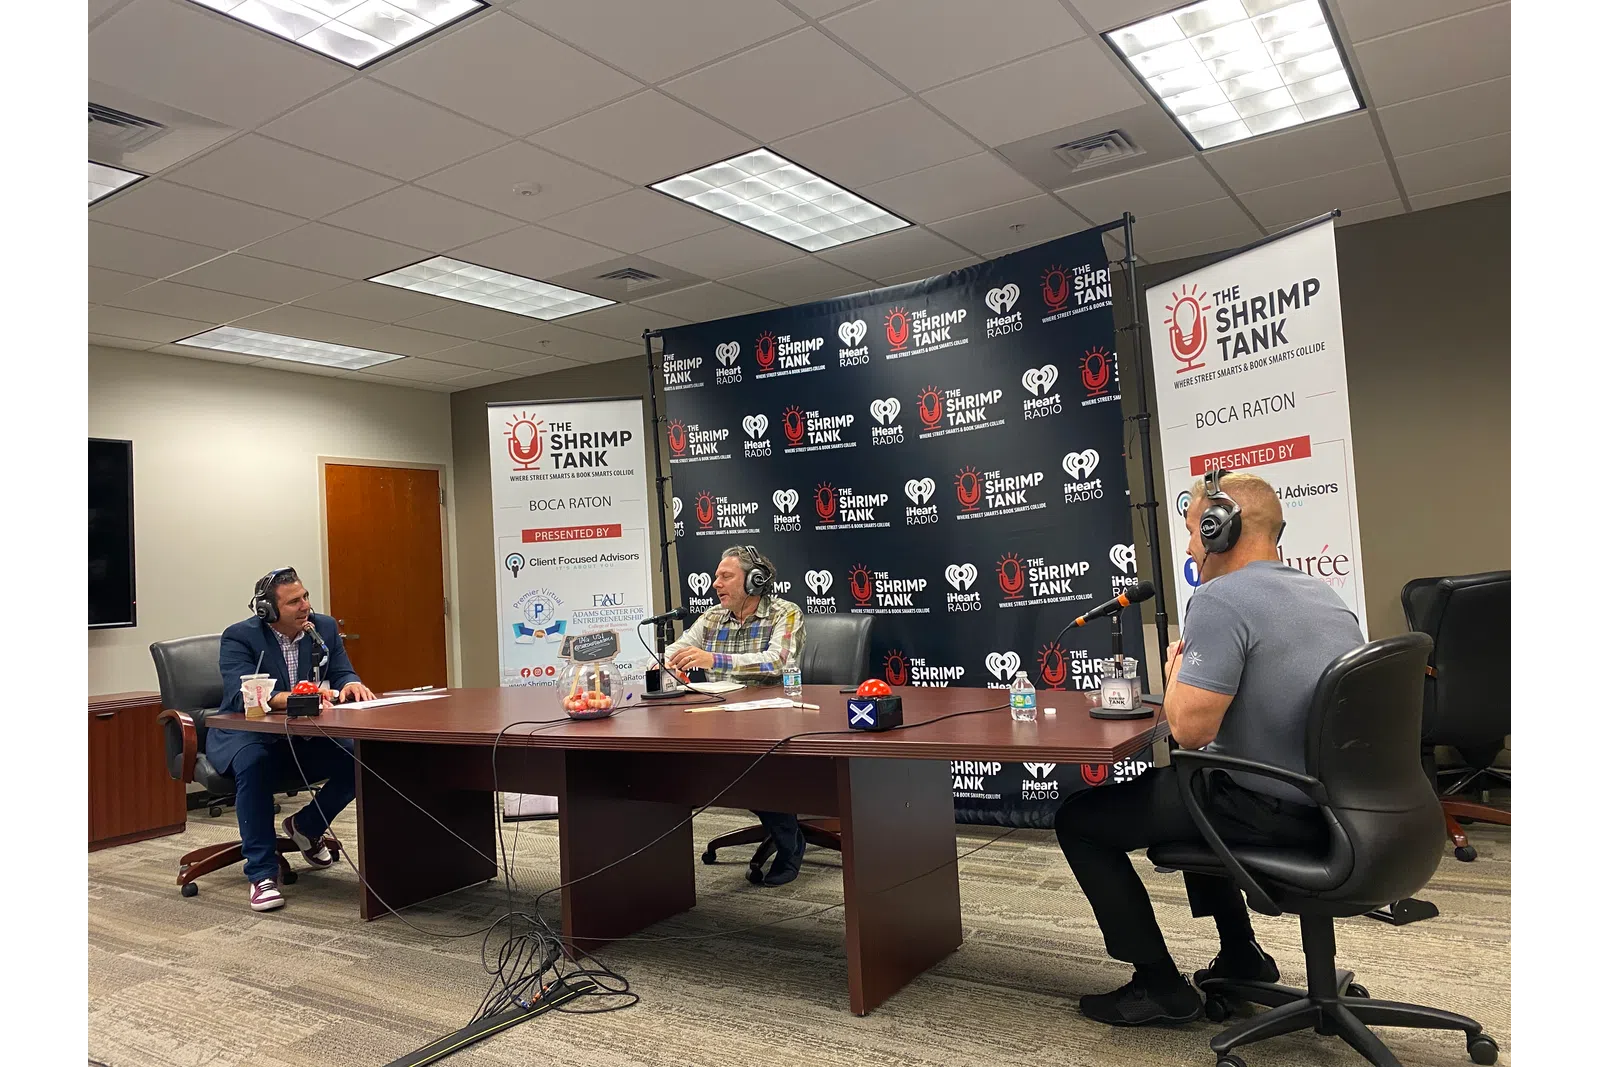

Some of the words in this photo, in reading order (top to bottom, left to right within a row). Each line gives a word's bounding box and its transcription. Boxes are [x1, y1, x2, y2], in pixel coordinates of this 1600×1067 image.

[1072, 264, 1091, 275] THE
[1074, 268, 1110, 290] SHRI
[1213, 285, 1240, 306] THE
[1057, 311, 1071, 319] STREET
[1072, 306, 1088, 315] SMARTS
[1215, 278, 1320, 333] SHRIMP
[912, 309, 927, 320] THE
[912, 309, 967, 334] SHRIMP
[986, 311, 1022, 328] iHeart
[913, 326, 951, 347] TANK
[987, 322, 1023, 339] RADIO
[778, 335, 791, 343] THE
[1217, 318, 1289, 361] TANK
[778, 337, 824, 356] SHRIMP
[839, 346, 868, 358] iHeart
[663, 357, 703, 373] SHRIMP
[779, 354, 811, 369] TANK
[839, 355, 869, 367] RADIO
[1174, 377, 1193, 389] WHERE
[1194, 371, 1216, 384] STREET
[1217, 365, 1242, 379] SMARTS
[1250, 358, 1268, 370] BOOK
[1269, 350, 1295, 365] SMARTS
[1296, 342, 1325, 356] COLLIDE
[664, 372, 691, 385] TANK
[716, 366, 741, 377] iHeart
[716, 375, 742, 385] RADIO
[945, 388, 961, 398] THE
[946, 389, 1003, 412] SHRIMP
[1023, 393, 1061, 411] iHeart
[947, 408, 987, 426] TANK
[1024, 404, 1062, 420] RADIO
[1196, 405, 1238, 429] BOCA
[1243, 392, 1295, 414] RATON
[549, 422, 572, 432] THE
[687, 424, 699, 432] THE
[807, 414, 854, 432] SHRIMP
[688, 429, 729, 444] SHRIMP
[808, 429, 841, 444] TANK
[872, 425, 903, 437] iHeart
[550, 431, 632, 450] SHRIMP
[744, 440, 770, 450] iHeart
[872, 434, 904, 446] RADIO
[689, 442, 718, 456] TANK
[744, 448, 772, 458] RADIO
[551, 451, 608, 469] TANK
[1204, 447, 1274, 471] PRESENTED
[1278, 444, 1295, 458] BY
[984, 470, 1000, 479] THE
[985, 471, 1044, 494] SHRIMP
[1064, 478, 1102, 493] iHeart
[1065, 489, 1104, 504] RADIO
[1285, 483, 1338, 499] Advisors
[530, 499, 565, 511] BOCA
[570, 496, 611, 508] RATON
[839, 493, 888, 508] SHRIMP
[986, 490, 1027, 508] TANK
[1286, 500, 1303, 508] YOU
[717, 502, 759, 516] SHRIMP
[840, 508, 874, 522] TANK
[906, 505, 937, 516] iHeart
[717, 517, 747, 528] TANK
[774, 514, 800, 523] iHeart
[906, 514, 939, 525] RADIO
[535, 529, 593, 540] PRESENTED
[597, 528, 609, 537] BY
[774, 523, 801, 532] RADIO
[530, 558, 556, 567] Client
[558, 555, 598, 564] Focused
[600, 553, 639, 562] Advisors
[1027, 558, 1044, 567] THE
[874, 571, 888, 580] THE
[1028, 561, 1090, 583] SHRIMP
[875, 578, 927, 594] SHRIMP
[1030, 578, 1073, 597] TANK
[1112, 576, 1138, 586] iHea
[513, 589, 539, 609] Premier
[541, 588, 564, 606] Virtual
[593, 593, 624, 607] FAU
[689, 597, 713, 605] iHeart
[807, 596, 836, 606] iHeart
[876, 593, 913, 607] TANK
[947, 592, 980, 603] iHeart
[807, 605, 836, 614] RADIO
[947, 601, 982, 613] RADIO
[573, 614, 643, 624] ENTREPRENEURSHIP
[1070, 650, 1088, 659] THE
[910, 658, 925, 666] THE
[911, 666, 965, 680] SHRIMP
[1072, 675, 1105, 689] TAN
[952, 775, 984, 790] ANK
[1022, 780, 1058, 790] iHeart
[1022, 791, 1059, 800] RADIO
